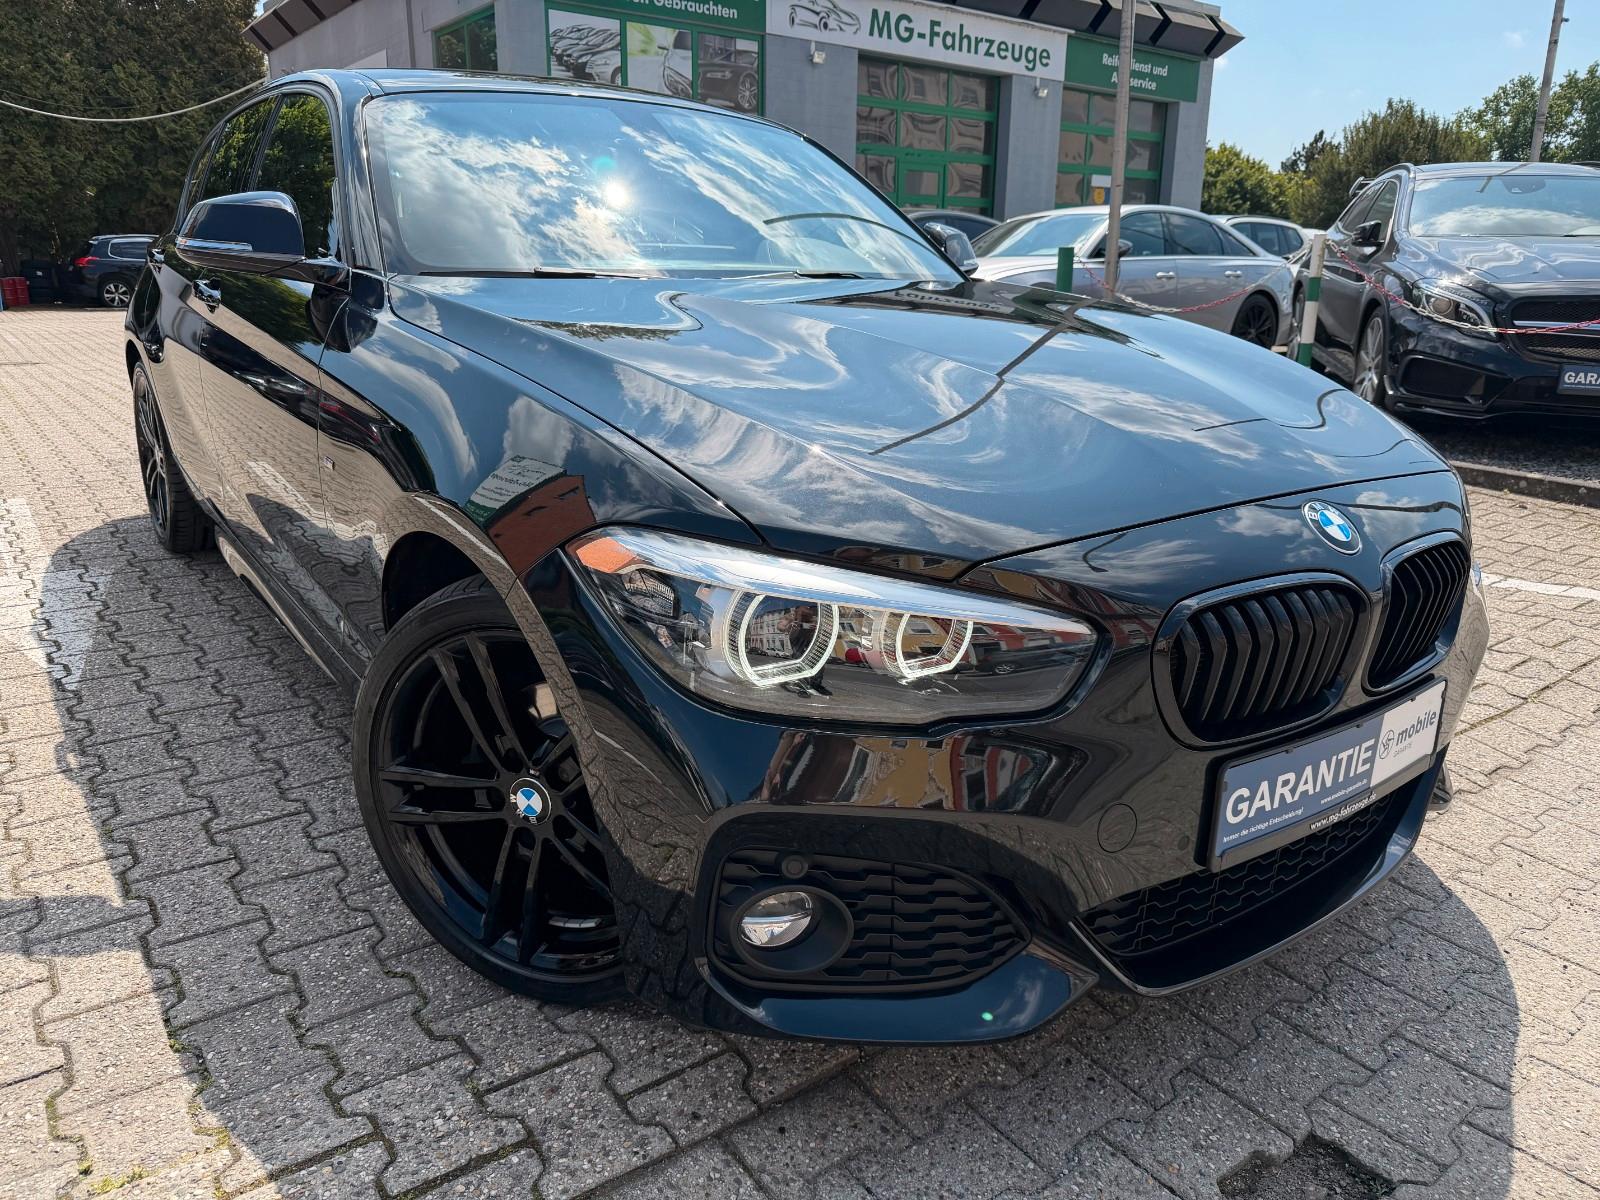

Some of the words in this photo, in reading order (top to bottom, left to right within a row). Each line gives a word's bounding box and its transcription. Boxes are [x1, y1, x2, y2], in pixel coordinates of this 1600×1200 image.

[653, 0, 738, 19] Gebrauchten
[868, 8, 1051, 72] MG-Fahrzeuge
[1111, 71, 1157, 91] Aservice
[1152, 65, 1168, 77] und
[1396, 710, 1437, 746] mobile
[1226, 738, 1375, 824] GARANTIE
